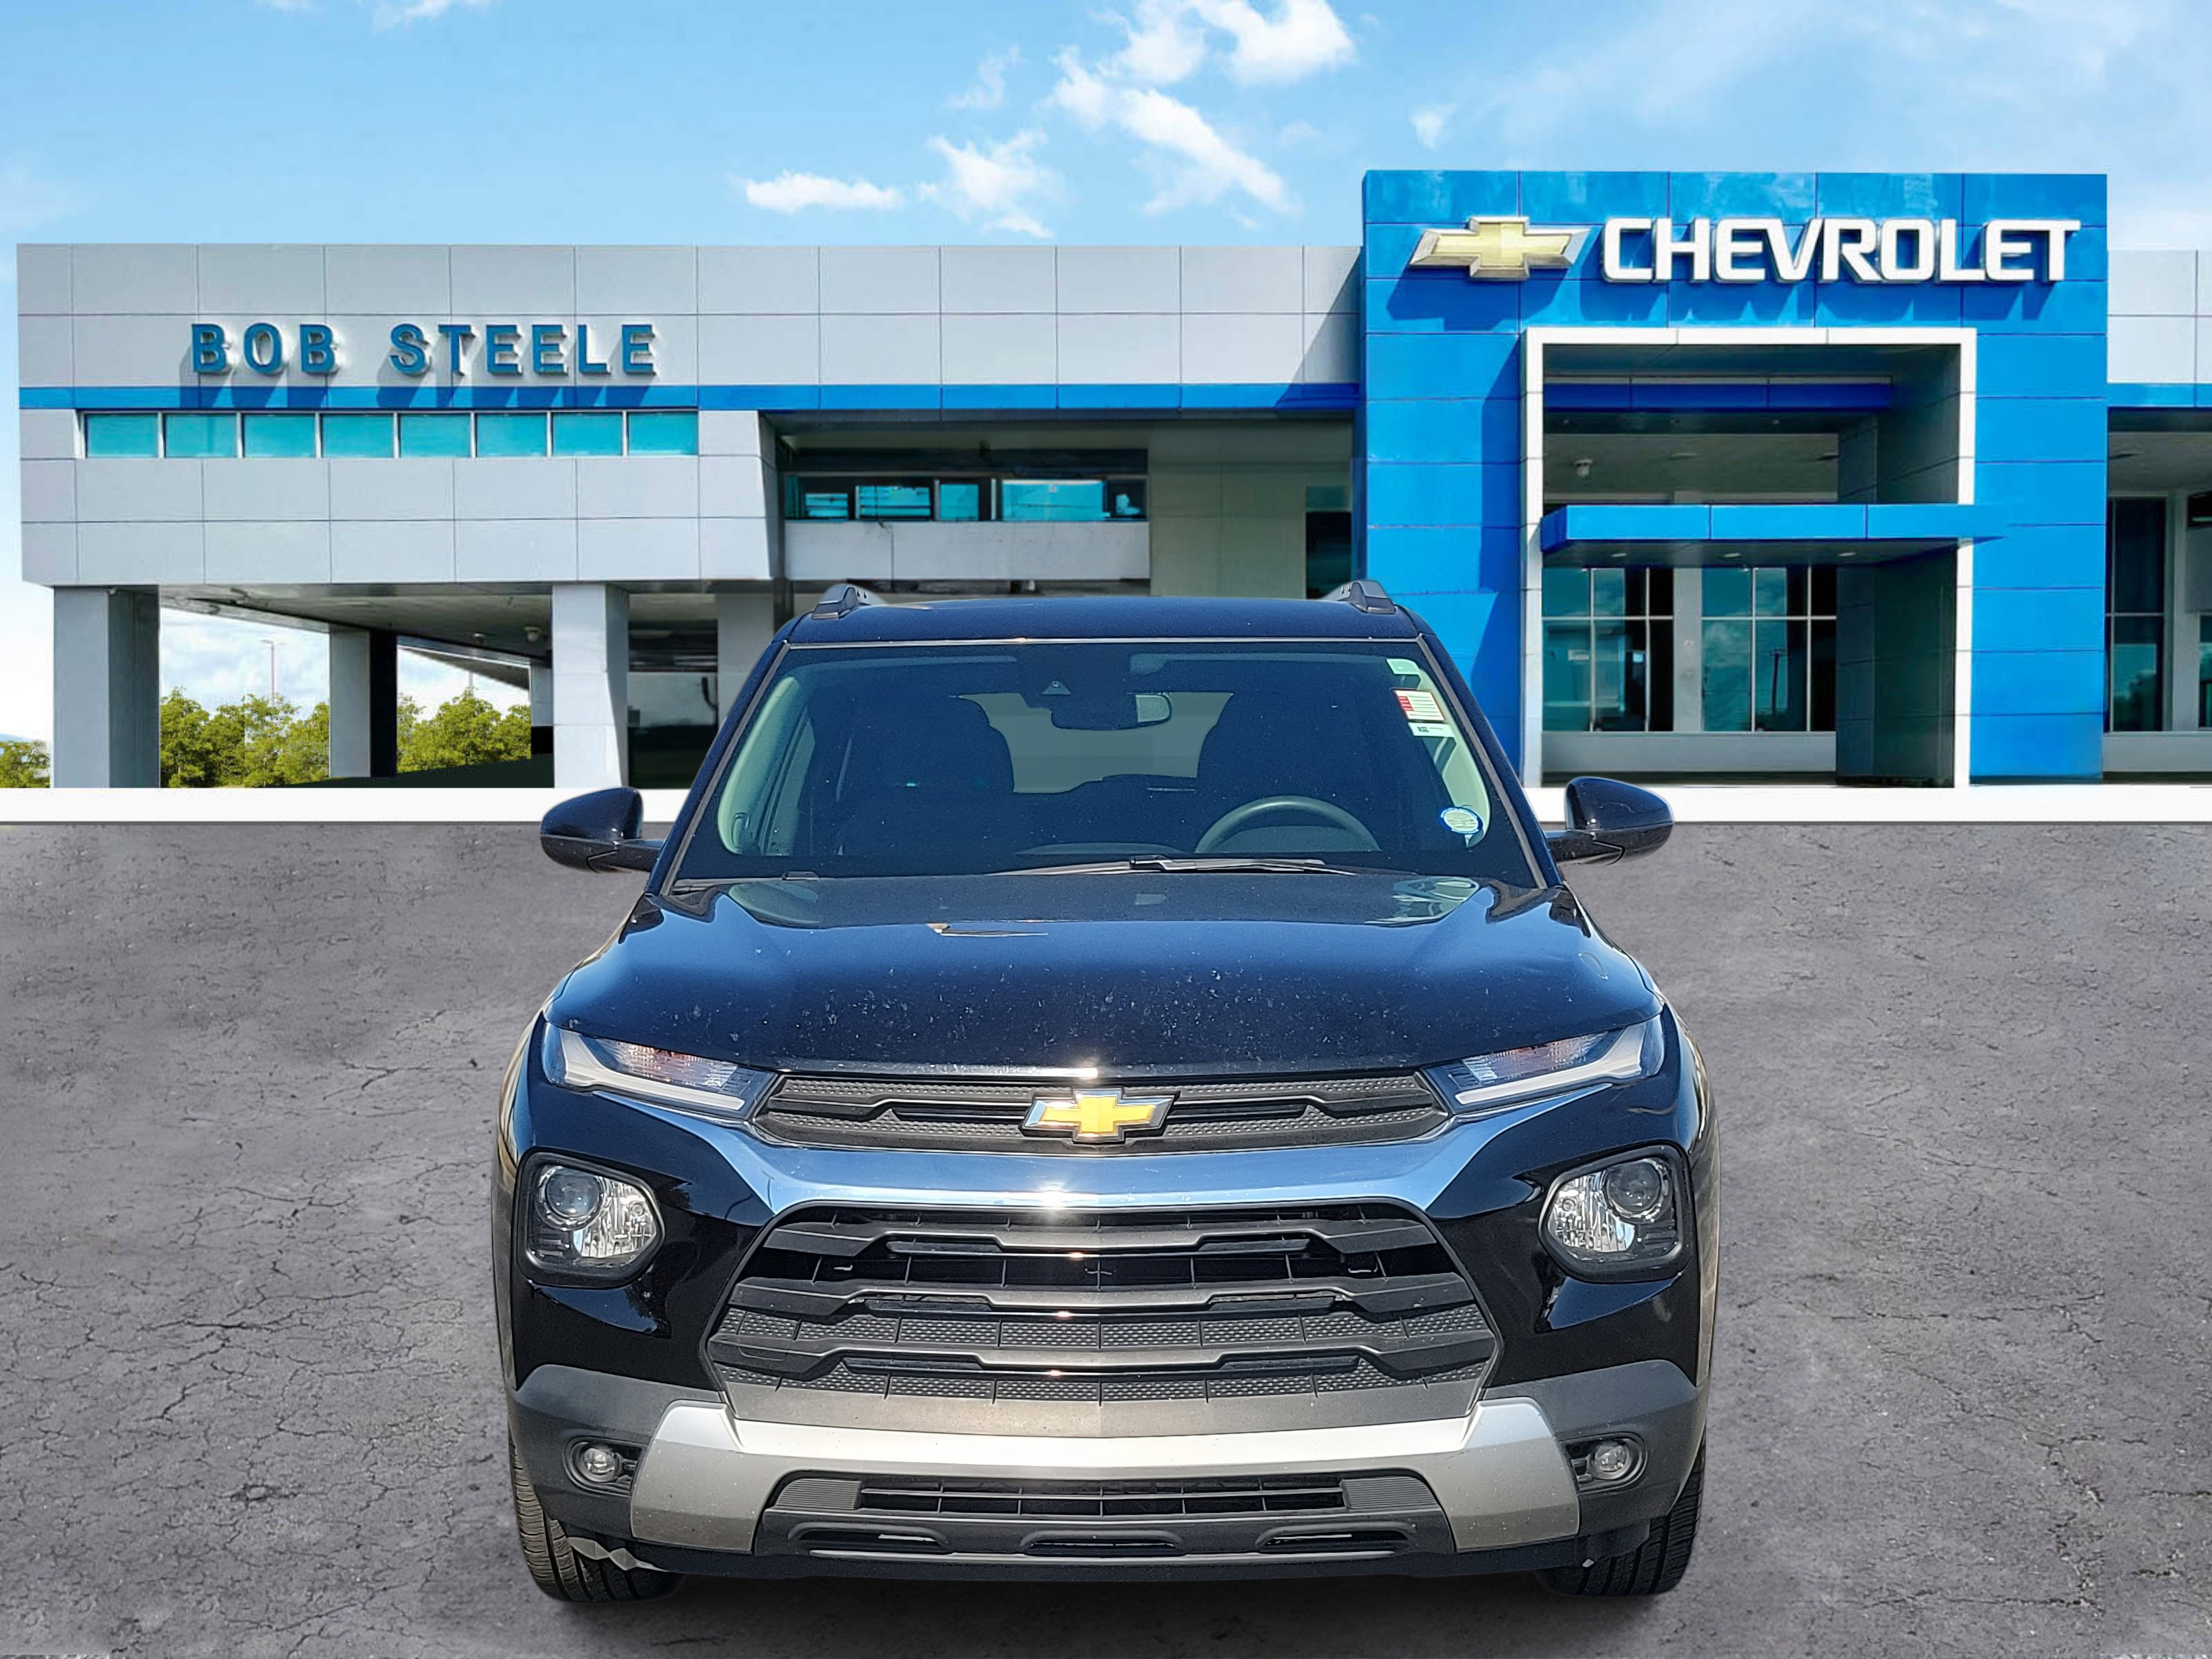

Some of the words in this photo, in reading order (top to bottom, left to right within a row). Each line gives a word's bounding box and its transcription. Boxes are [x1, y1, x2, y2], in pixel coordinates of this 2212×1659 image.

[1603, 218, 2080, 282] CHEVROLET
[192, 322, 339, 376] BOB
[390, 323, 656, 376] STEELE
